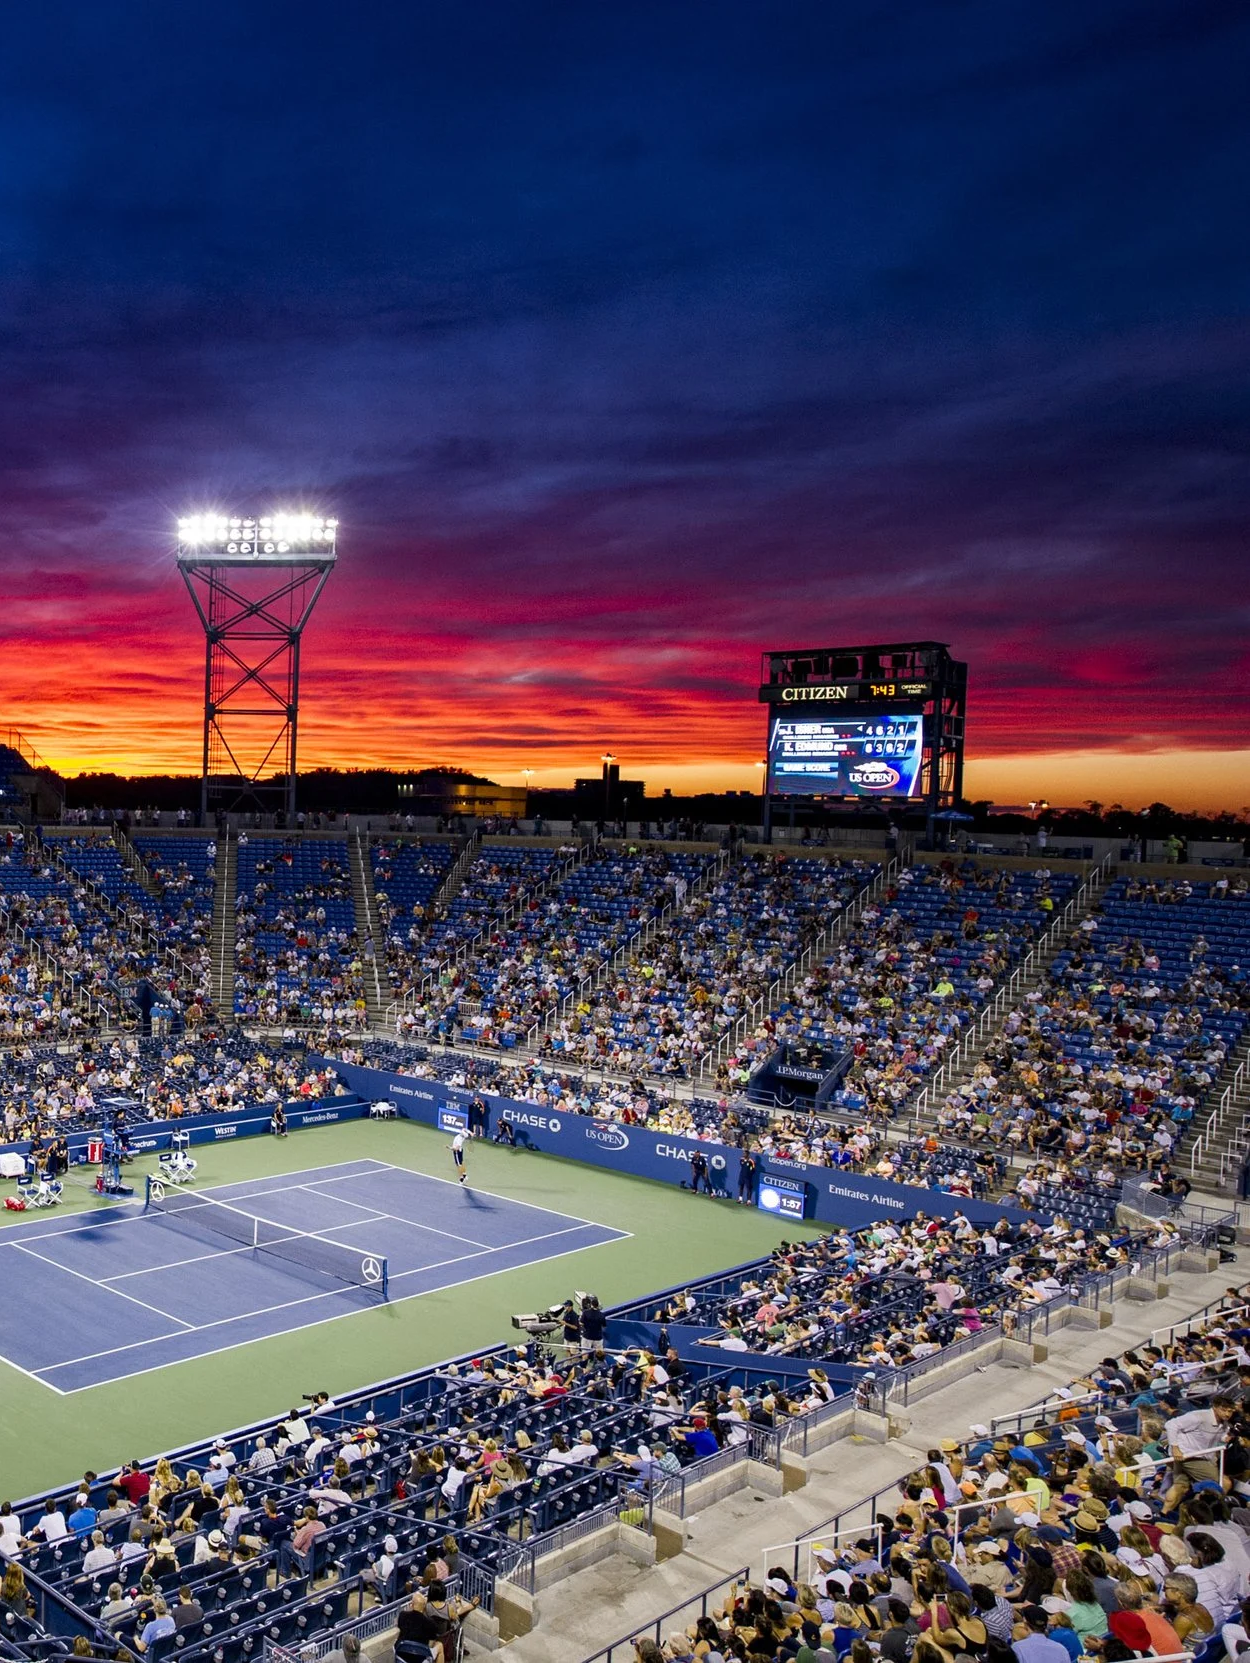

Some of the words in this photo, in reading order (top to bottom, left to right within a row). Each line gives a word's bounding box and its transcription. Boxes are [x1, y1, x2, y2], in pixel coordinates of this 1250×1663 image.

[781, 686, 849, 701] CITIZEN
[870, 684, 896, 696] 7:43
[866, 726, 873, 736] 4
[886, 725, 894, 736] 2
[898, 725, 904, 736] 1
[875, 743, 883, 754] 3
[896, 743, 905, 753] 2
[849, 772, 863, 783] US
[862, 772, 895, 783] OPEN
[120, 986, 138, 999] IBM
[776, 1065, 824, 1081] J.P.Morgan
[389, 1084, 413, 1097] Emirates
[414, 1089, 434, 1101] Airline
[445, 1101, 461, 1112] IBM
[302, 1112, 339, 1124] Mercedes-Benz
[442, 1114, 457, 1126] 137
[502, 1109, 547, 1129] CHASE
[585, 1128, 597, 1140] US
[597, 1131, 623, 1145] OPEN
[768, 1156, 807, 1171] usopen.org
[763, 1176, 800, 1191] CITIZEN
[828, 1183, 870, 1201] Emirates
[871, 1194, 905, 1209] Airline
